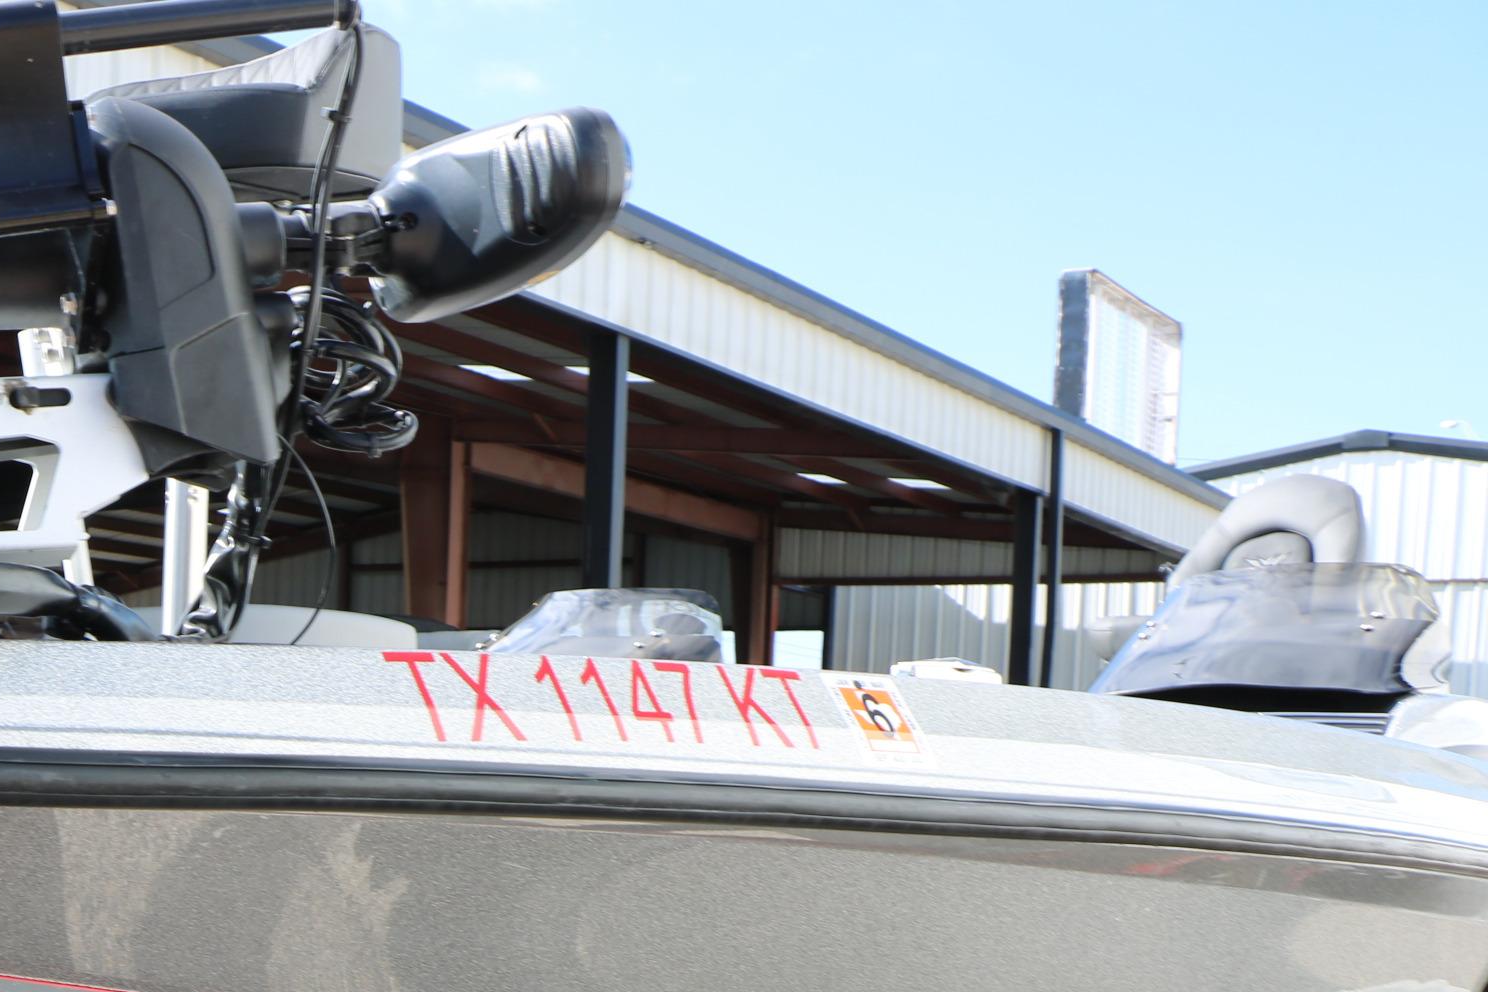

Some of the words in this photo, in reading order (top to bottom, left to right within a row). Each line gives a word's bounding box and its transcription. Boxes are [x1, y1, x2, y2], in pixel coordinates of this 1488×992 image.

[382, 651, 527, 742] TX
[534, 655, 703, 744] 1147
[716, 664, 819, 749] KT
